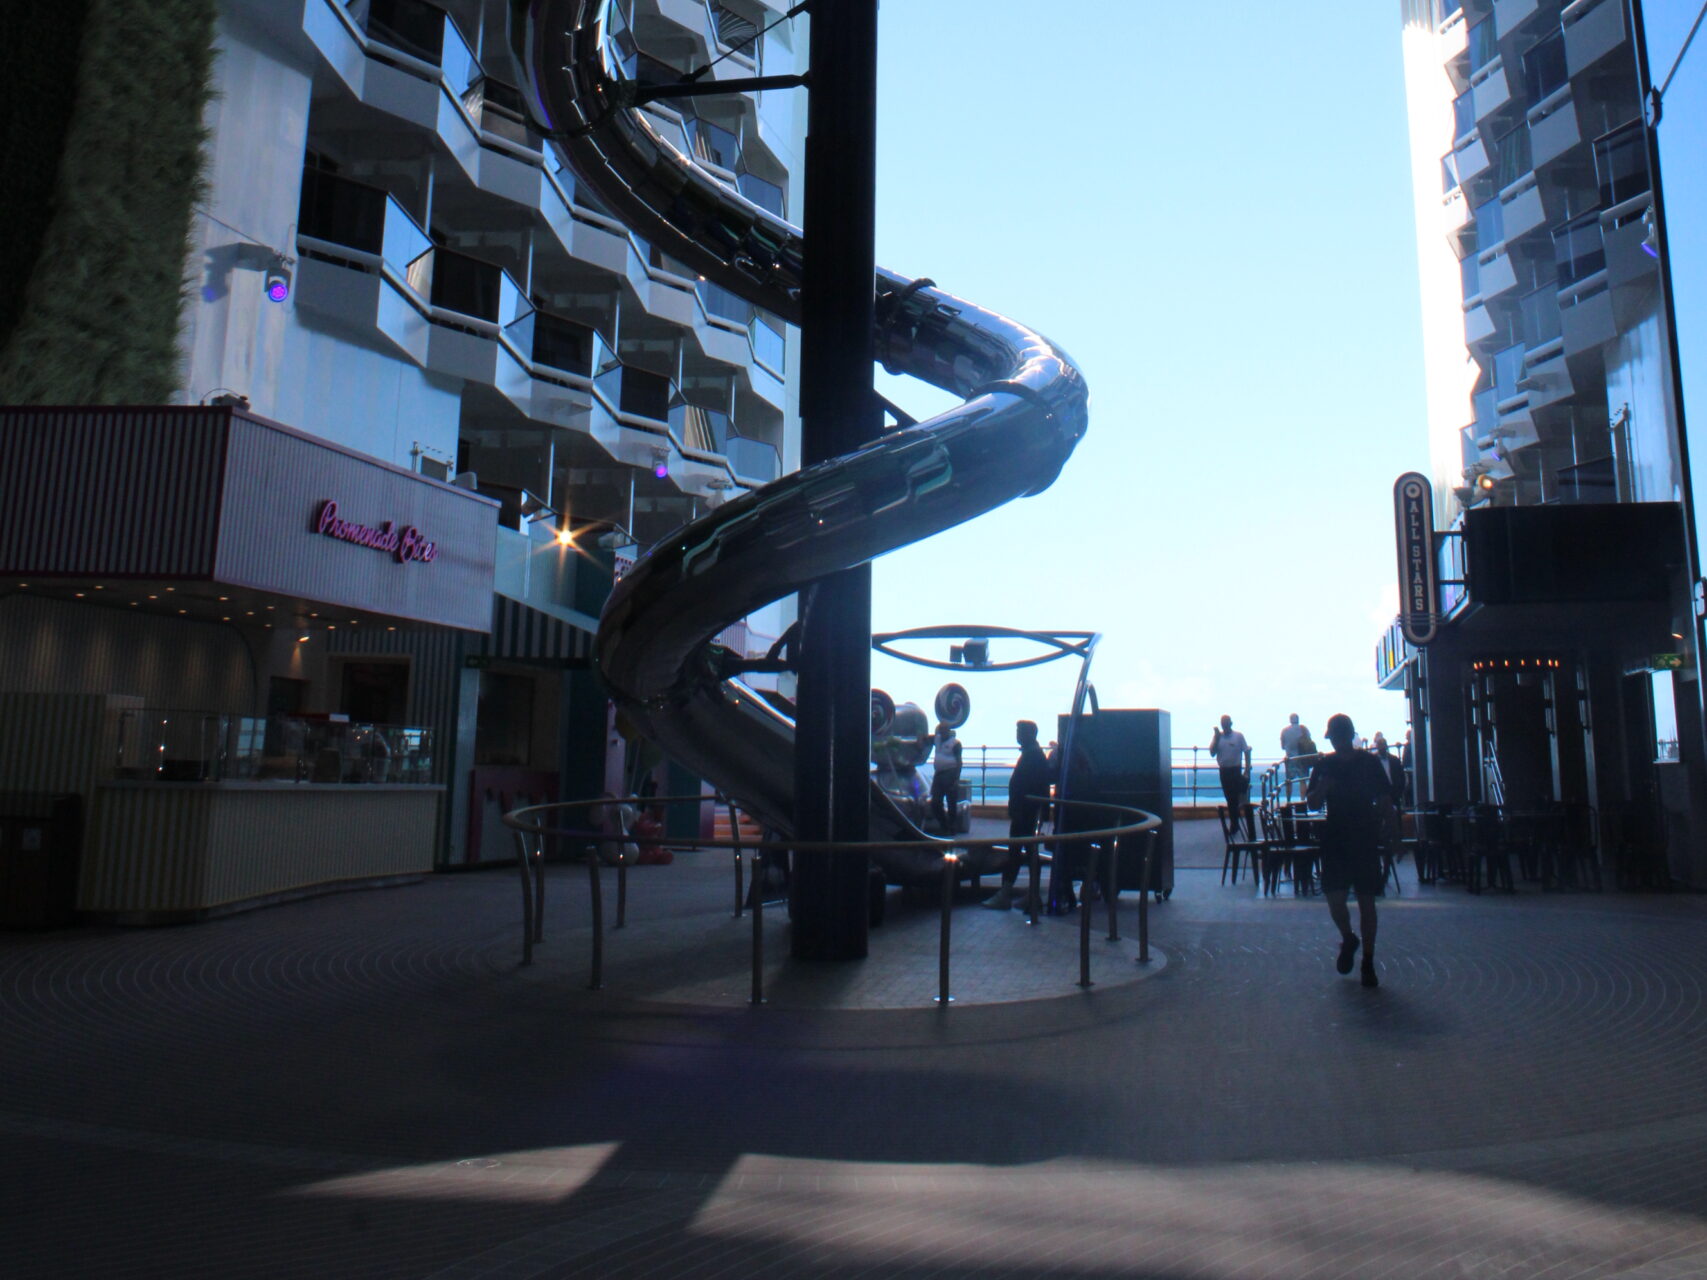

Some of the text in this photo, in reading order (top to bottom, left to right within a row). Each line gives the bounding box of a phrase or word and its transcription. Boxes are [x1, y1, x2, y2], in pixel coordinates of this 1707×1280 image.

[318, 500, 438, 563] Promenade Bites
[1409, 500, 1424, 611] ALL STARS
